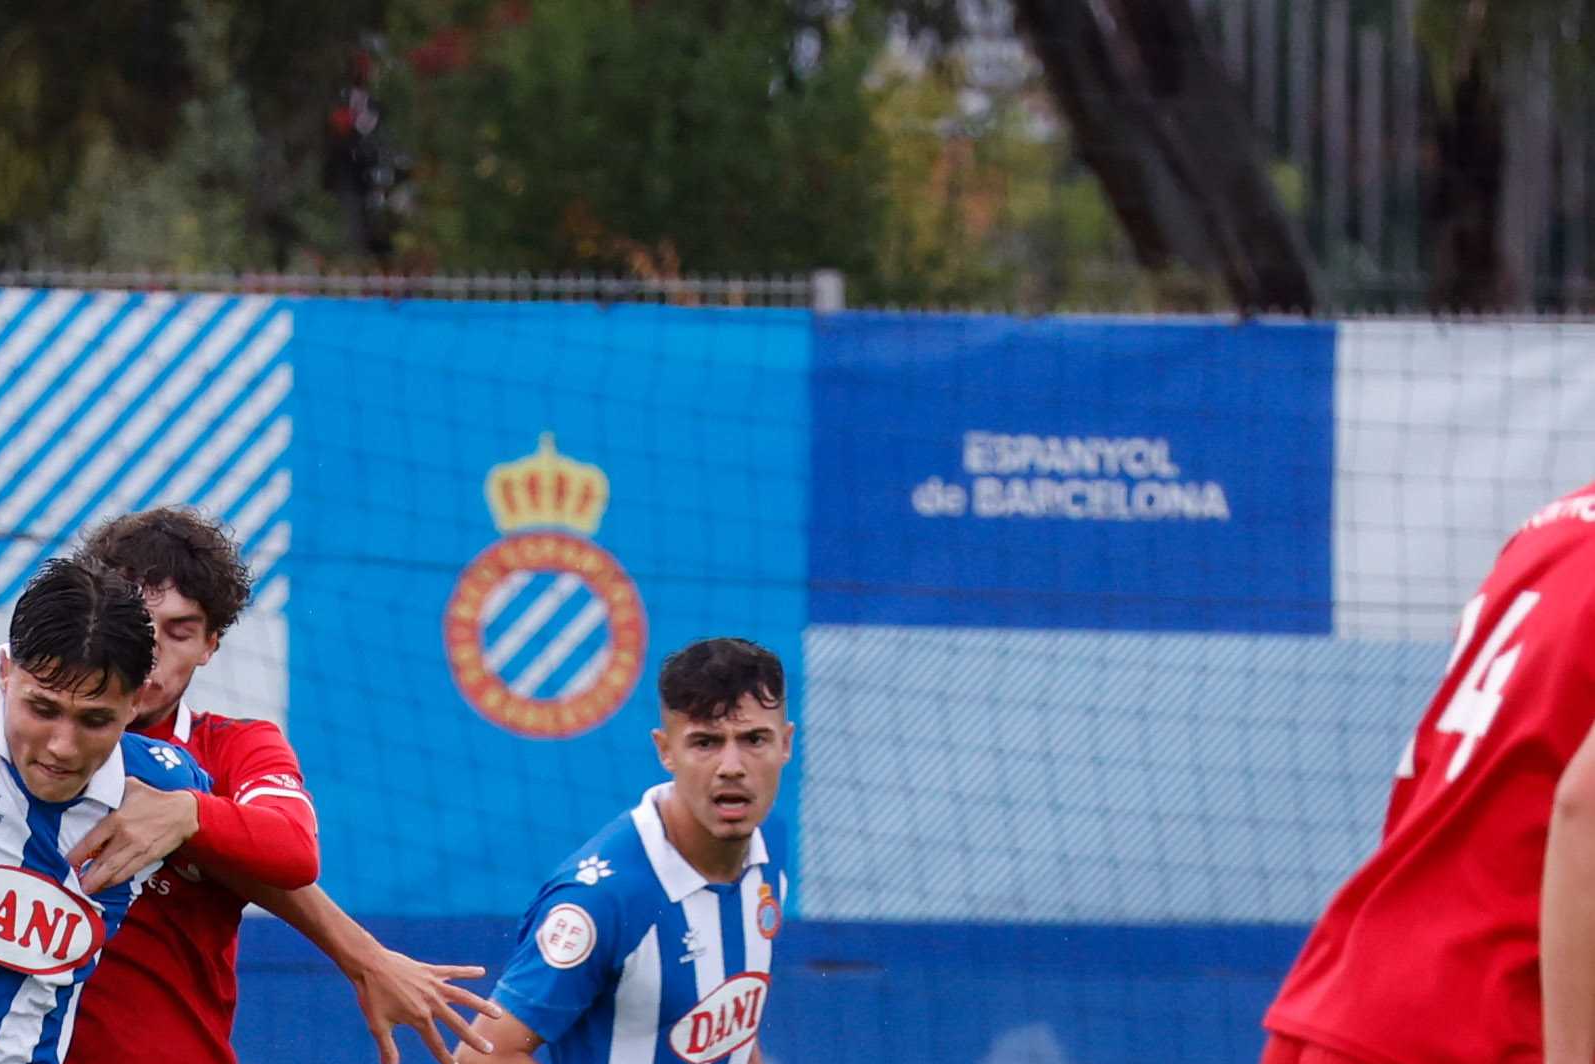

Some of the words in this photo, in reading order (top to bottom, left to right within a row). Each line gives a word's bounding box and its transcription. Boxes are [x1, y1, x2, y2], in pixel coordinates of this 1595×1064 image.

[964, 432, 1178, 477] ESPANYOL
[911, 474, 967, 518] de
[972, 477, 1229, 519] BARCELONA
[686, 986, 762, 1054] DANI
